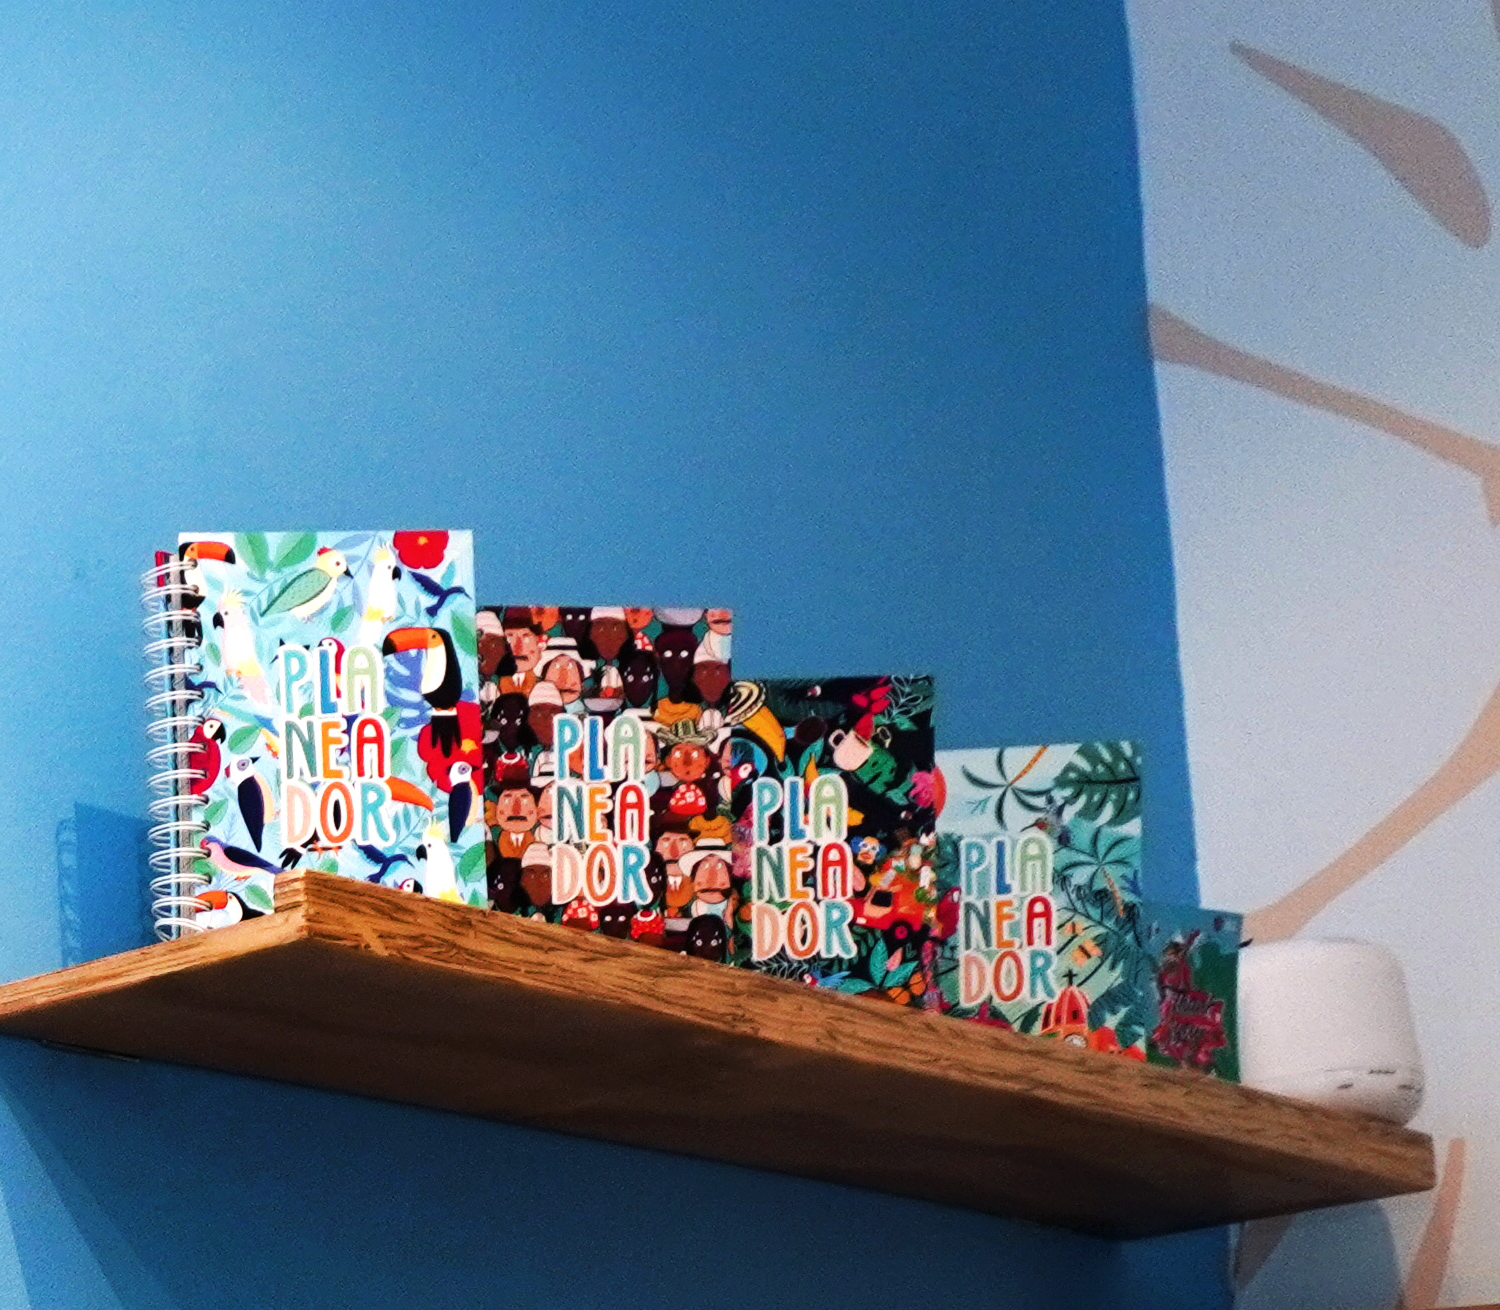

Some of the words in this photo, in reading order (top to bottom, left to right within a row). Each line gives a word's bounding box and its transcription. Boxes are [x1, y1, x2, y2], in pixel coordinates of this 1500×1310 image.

[278, 646, 383, 714] PLA
[284, 715, 390, 781] NEA
[553, 714, 643, 781] PLA
[282, 781, 395, 846] DOR
[555, 783, 650, 843] NEA
[752, 774, 848, 842] PLA
[553, 845, 653, 905] DOR
[752, 842, 852, 902] NEA
[960, 834, 1054, 898] PLA
[752, 902, 856, 962] DOR
[960, 896, 1056, 950] NEA
[960, 950, 1058, 1005] DOR
